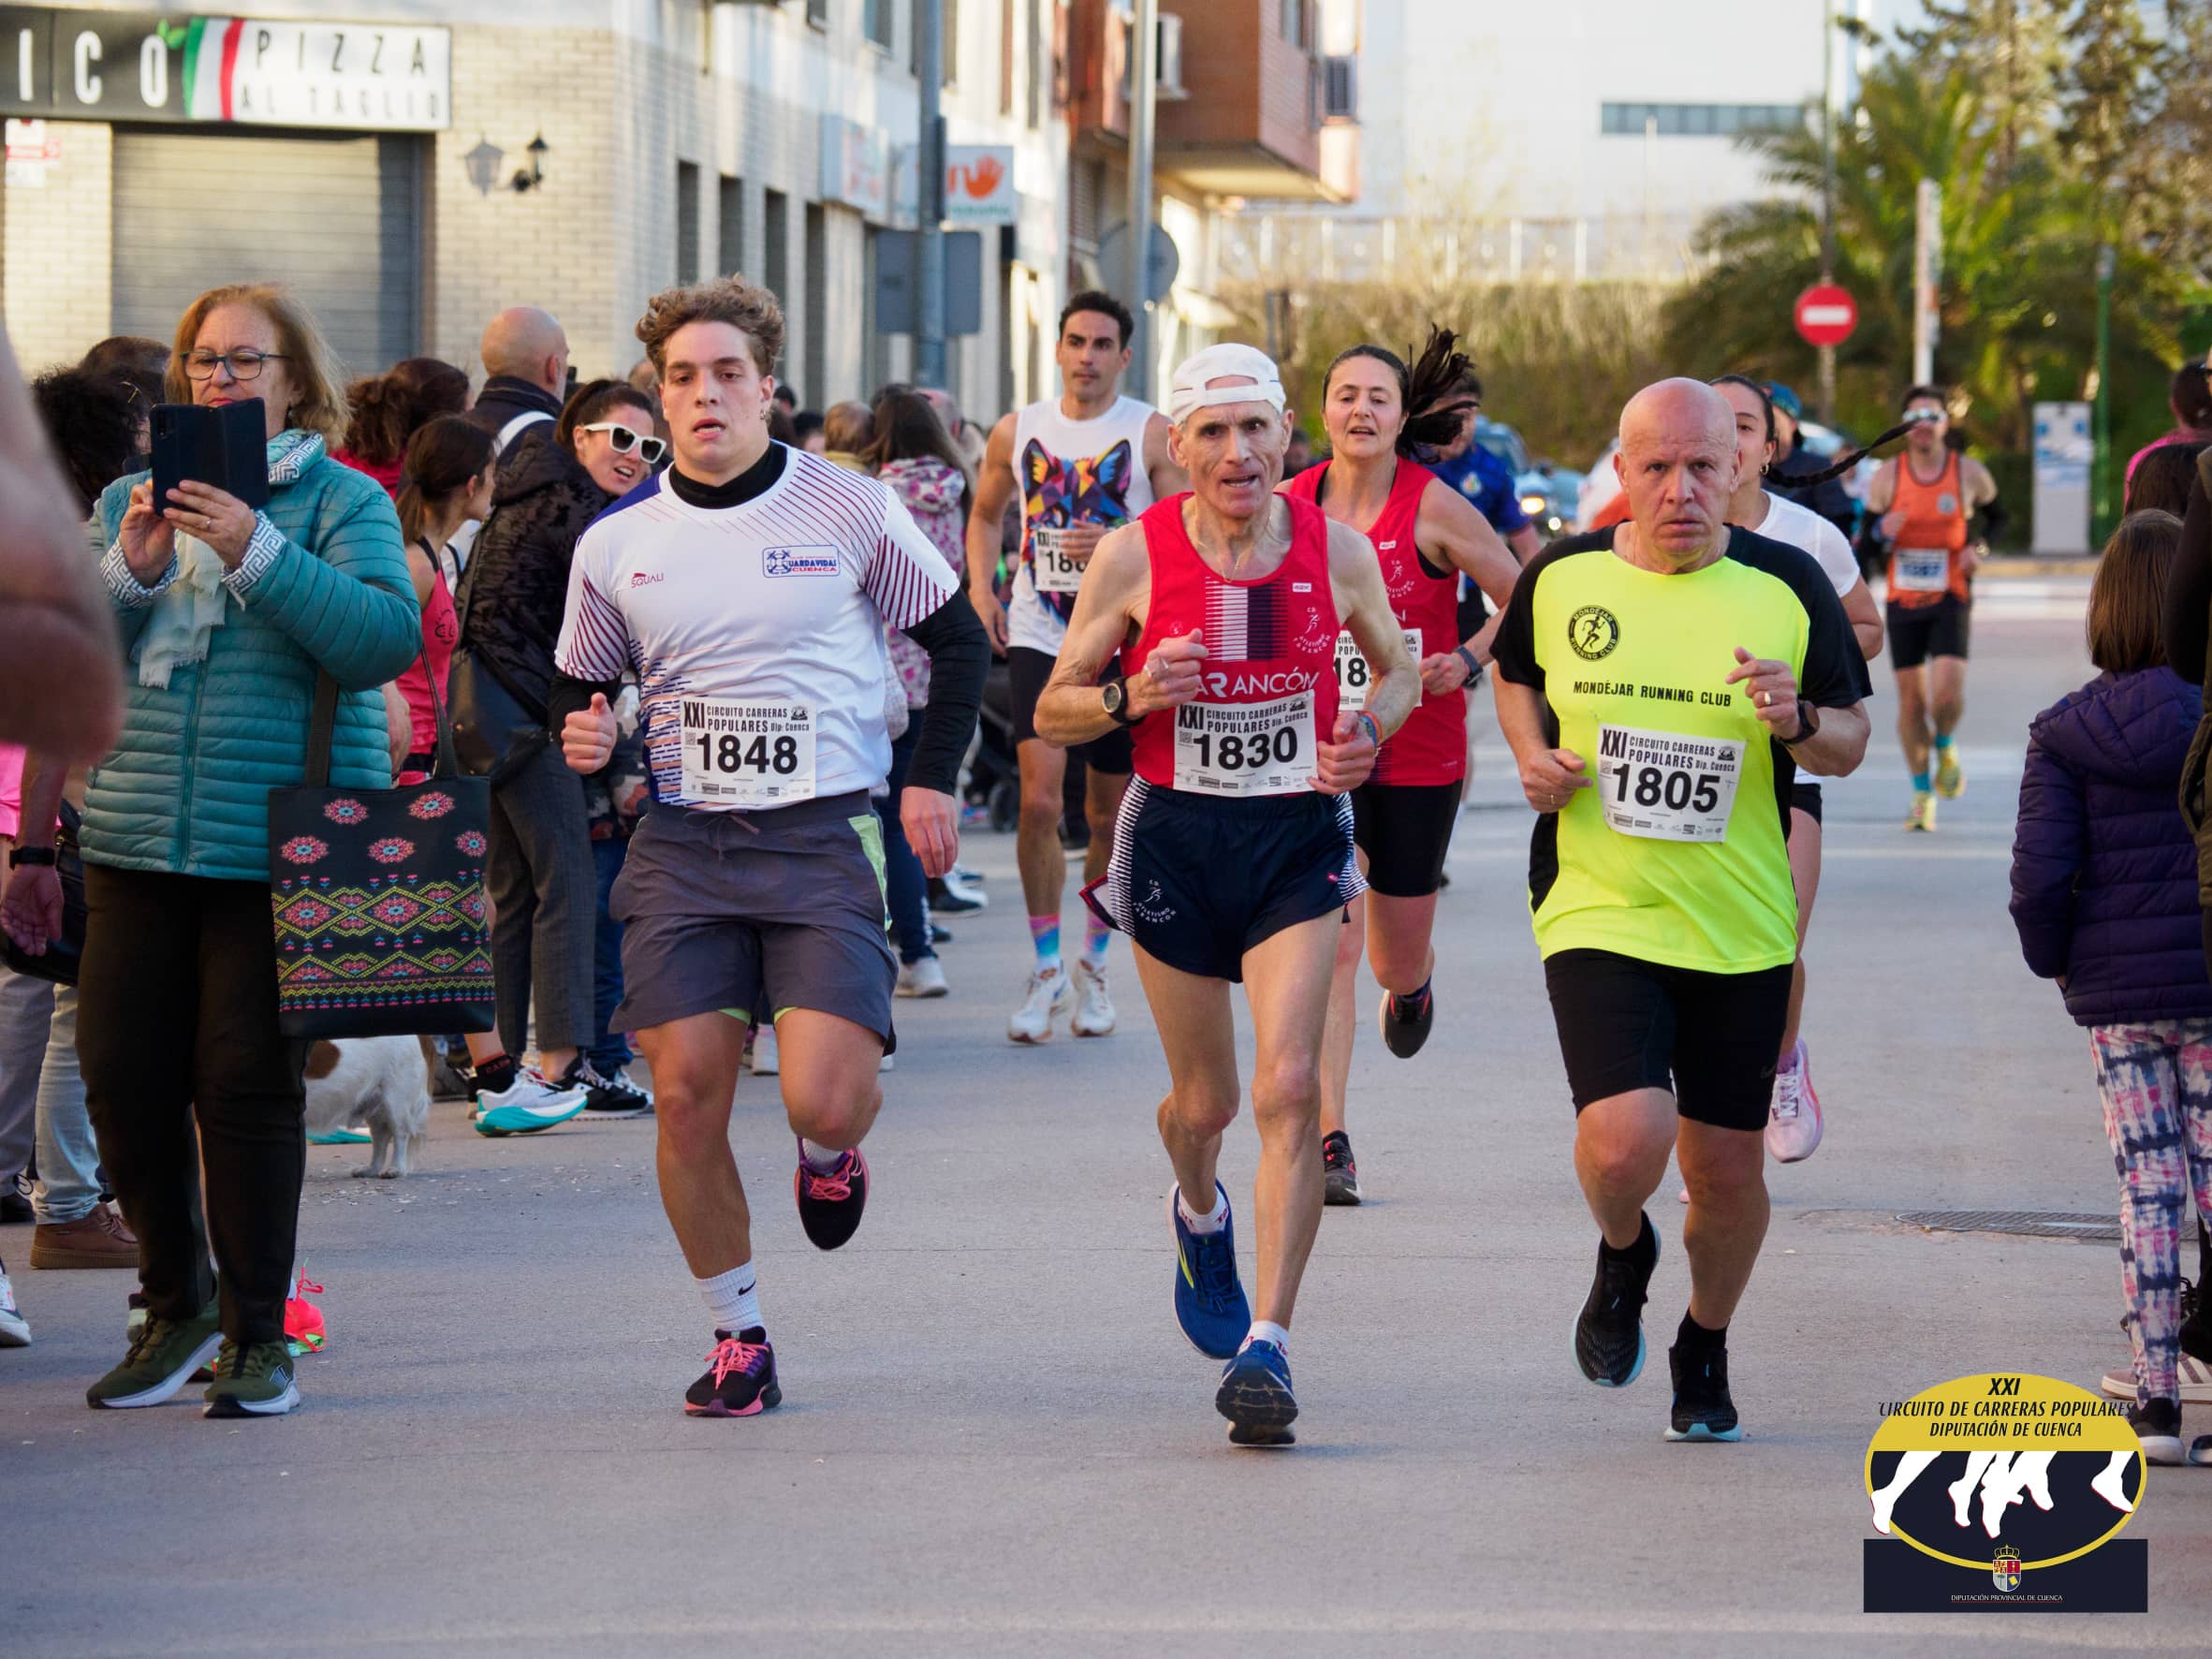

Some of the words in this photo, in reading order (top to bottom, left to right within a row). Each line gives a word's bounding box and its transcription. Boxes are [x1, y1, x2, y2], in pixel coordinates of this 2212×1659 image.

[257, 29, 427, 77] PIZZA
[18, 29, 169, 108] ICO
[240, 82, 276, 115] AL
[309, 85, 440, 120] TAGLIO
[1046, 551, 1087, 573] 18
[1339, 646, 1360, 655] POPU
[1196, 667, 1319, 698] ARANCÓN
[1334, 657, 1369, 687] 18
[1574, 680, 1633, 697] MONDÉJAR
[1640, 685, 1693, 703] RUNNING
[1700, 692, 1732, 707] CLUB
[683, 701, 705, 728] XXI
[707, 705, 743, 717] CIRCUITO
[746, 708, 788, 718] CARRERAS
[1179, 704, 1204, 730] XXI
[1206, 710, 1246, 721] CIRCUITO
[1249, 703, 1287, 720] CARRERAS
[1208, 720, 1269, 734] POPULARES
[1284, 712, 1308, 724] Cuenca
[708, 719, 769, 732] POPULARES
[785, 723, 810, 731] Cuenca
[697, 733, 798, 774] 1848
[1194, 726, 1297, 771] 1830
[1601, 728, 1628, 759] XXI
[1629, 736, 1669, 752] CIRCUITO
[1672, 741, 1715, 756] CARRERAS
[1628, 749, 1692, 769] POPULARES
[1710, 761, 1735, 771] Cuenca
[1613, 763, 1721, 814] 1805
